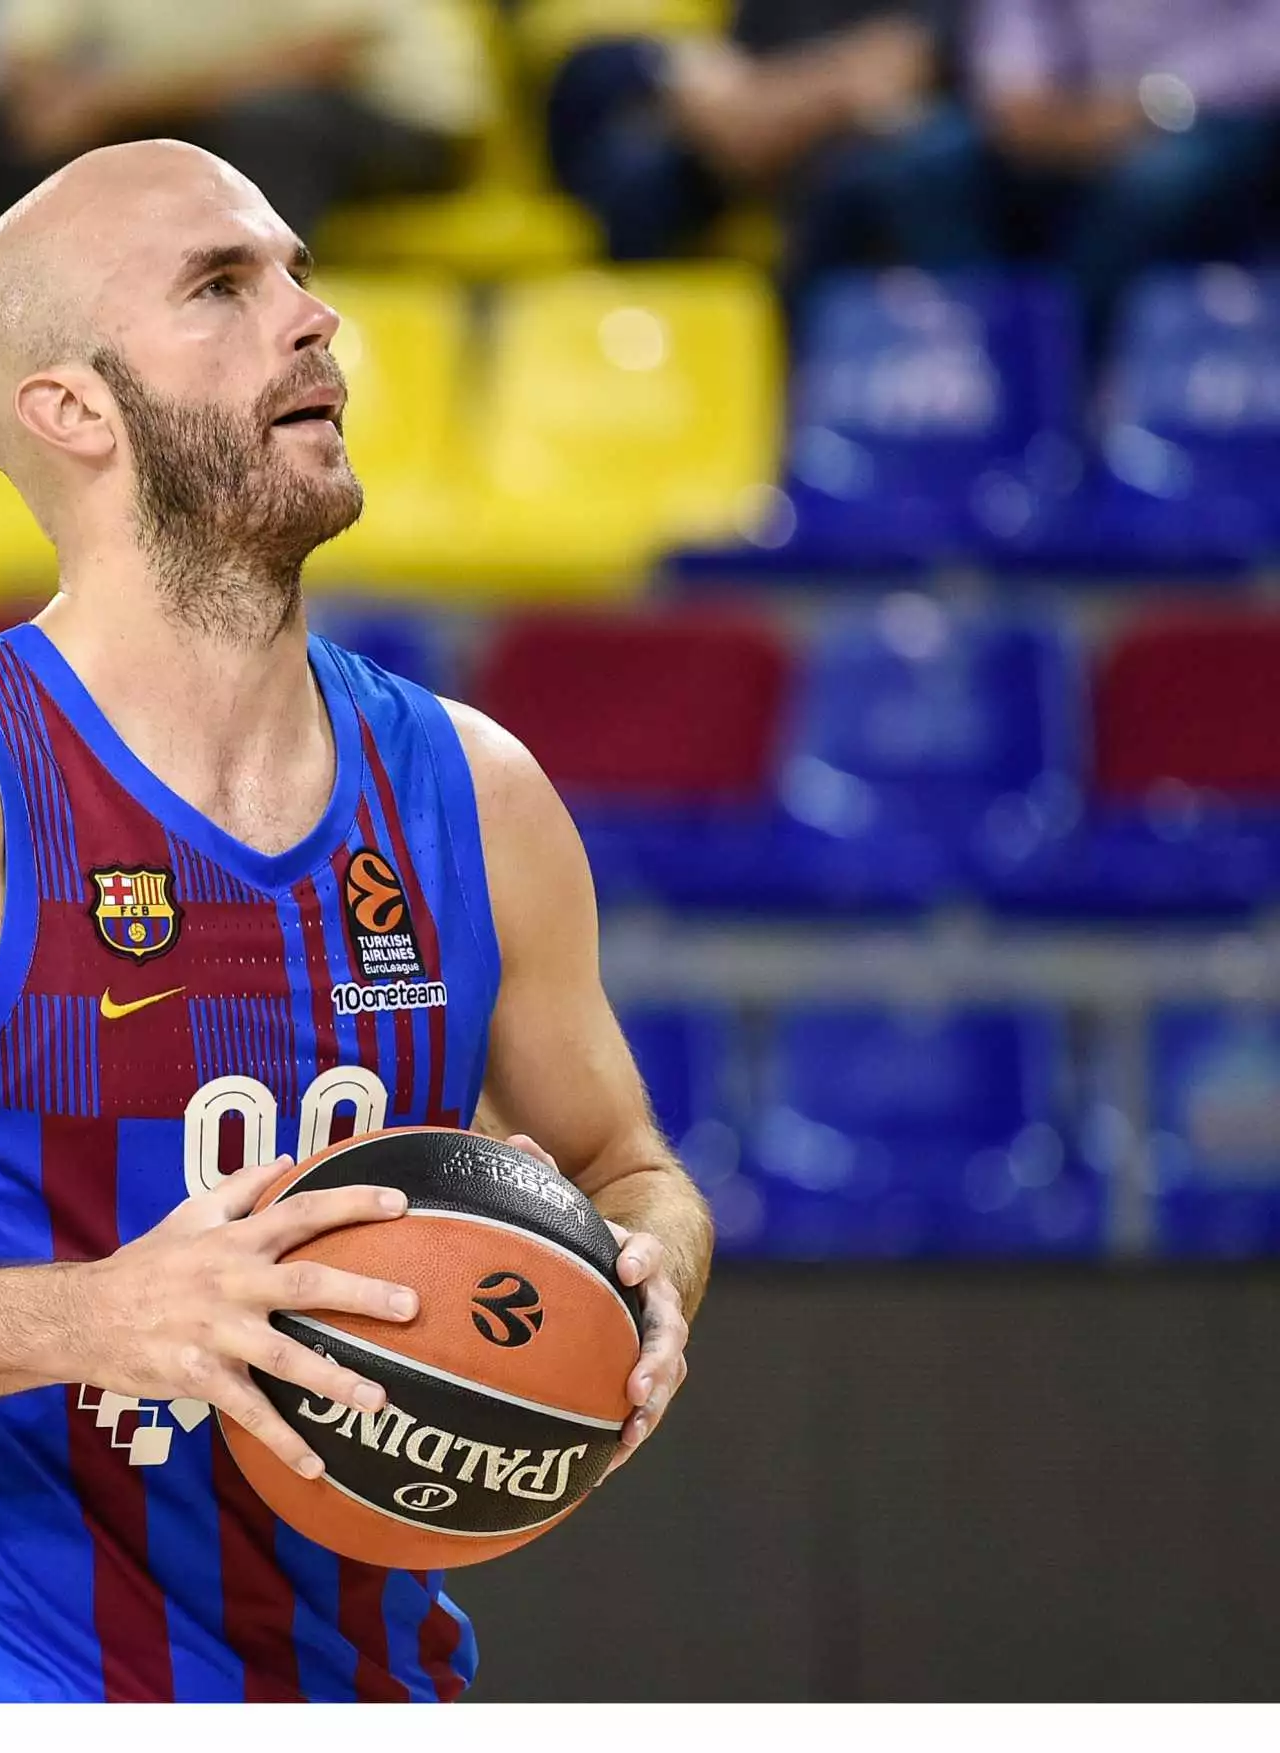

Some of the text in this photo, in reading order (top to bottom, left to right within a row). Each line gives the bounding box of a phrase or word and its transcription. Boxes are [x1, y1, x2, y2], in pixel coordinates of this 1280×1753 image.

[120, 906, 150, 916] FCB
[357, 933, 412, 948] TURKISH
[362, 947, 416, 962] AIRLINES
[363, 962, 420, 975] EuroLeague
